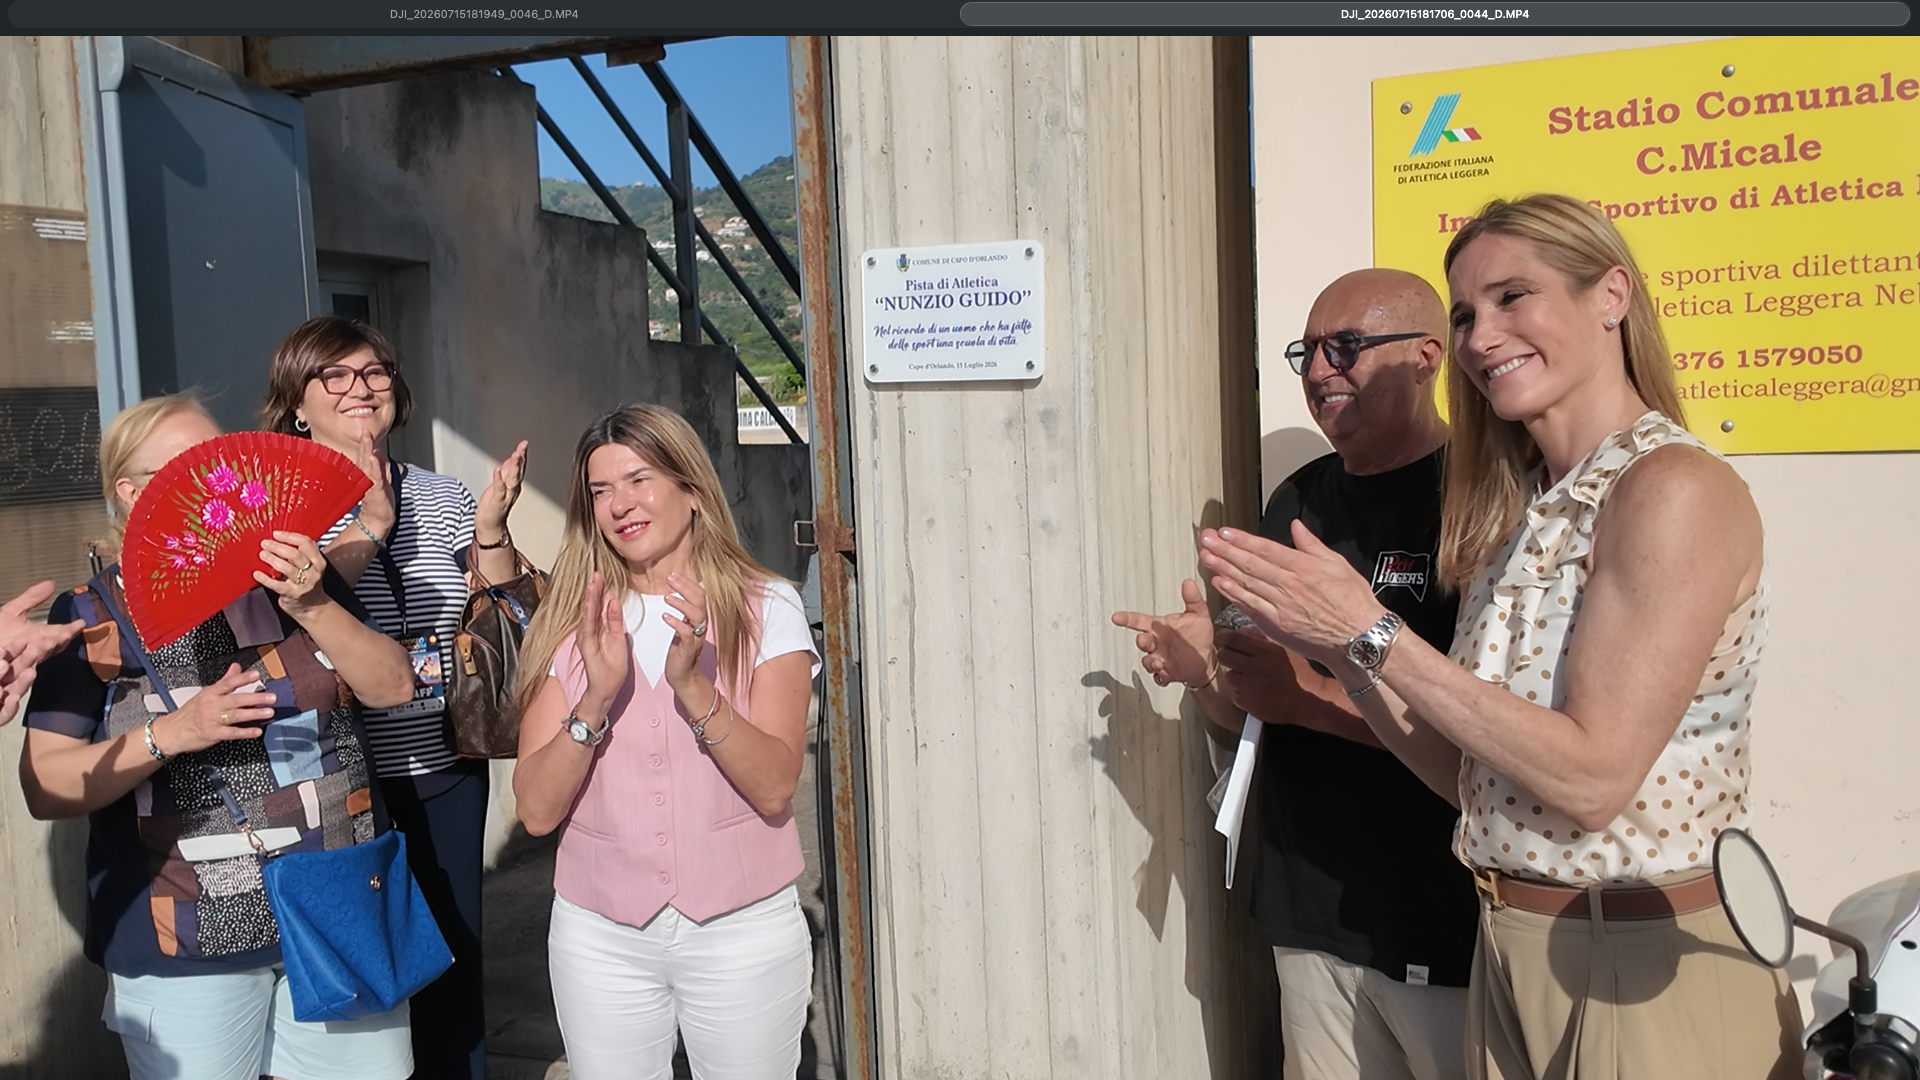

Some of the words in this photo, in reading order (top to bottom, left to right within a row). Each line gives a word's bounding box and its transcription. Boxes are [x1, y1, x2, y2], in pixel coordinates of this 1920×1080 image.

[1549, 97, 1681, 134] Stadio
[1696, 72, 1920, 120] Comunale
[1393, 160, 1452, 173] FEDERAZIONE
[1454, 155, 1495, 167] ITALIANA
[1636, 133, 1822, 175] C.Micale
[1398, 176, 1408, 184] DI
[1408, 172, 1448, 183] ATLETICA
[1450, 168, 1490, 179] LEGGERA
[1730, 185, 1760, 210] di
[1771, 177, 1904, 207] Atletica
[951, 256, 968, 264] CAPO
[905, 279, 934, 291] Pista
[937, 278, 949, 289] di
[952, 276, 998, 288] Atletica
[1660, 260, 1782, 292] sportiva
[1653, 295, 1734, 318] letica
[1744, 290, 1864, 318] Leggera
[874, 325, 891, 338] Nel
[892, 323, 926, 335] ricordo
[928, 323, 938, 334] di
[952, 325, 977, 333] uomo
[979, 320, 995, 332] che
[997, 320, 1009, 331] ha
[911, 337, 936, 352] sport
[936, 339, 954, 347] una
[956, 335, 985, 349] scuola
[987, 335, 997, 346] di
[1672, 350, 1725, 371] 376
[1737, 345, 1863, 368] 1579050
